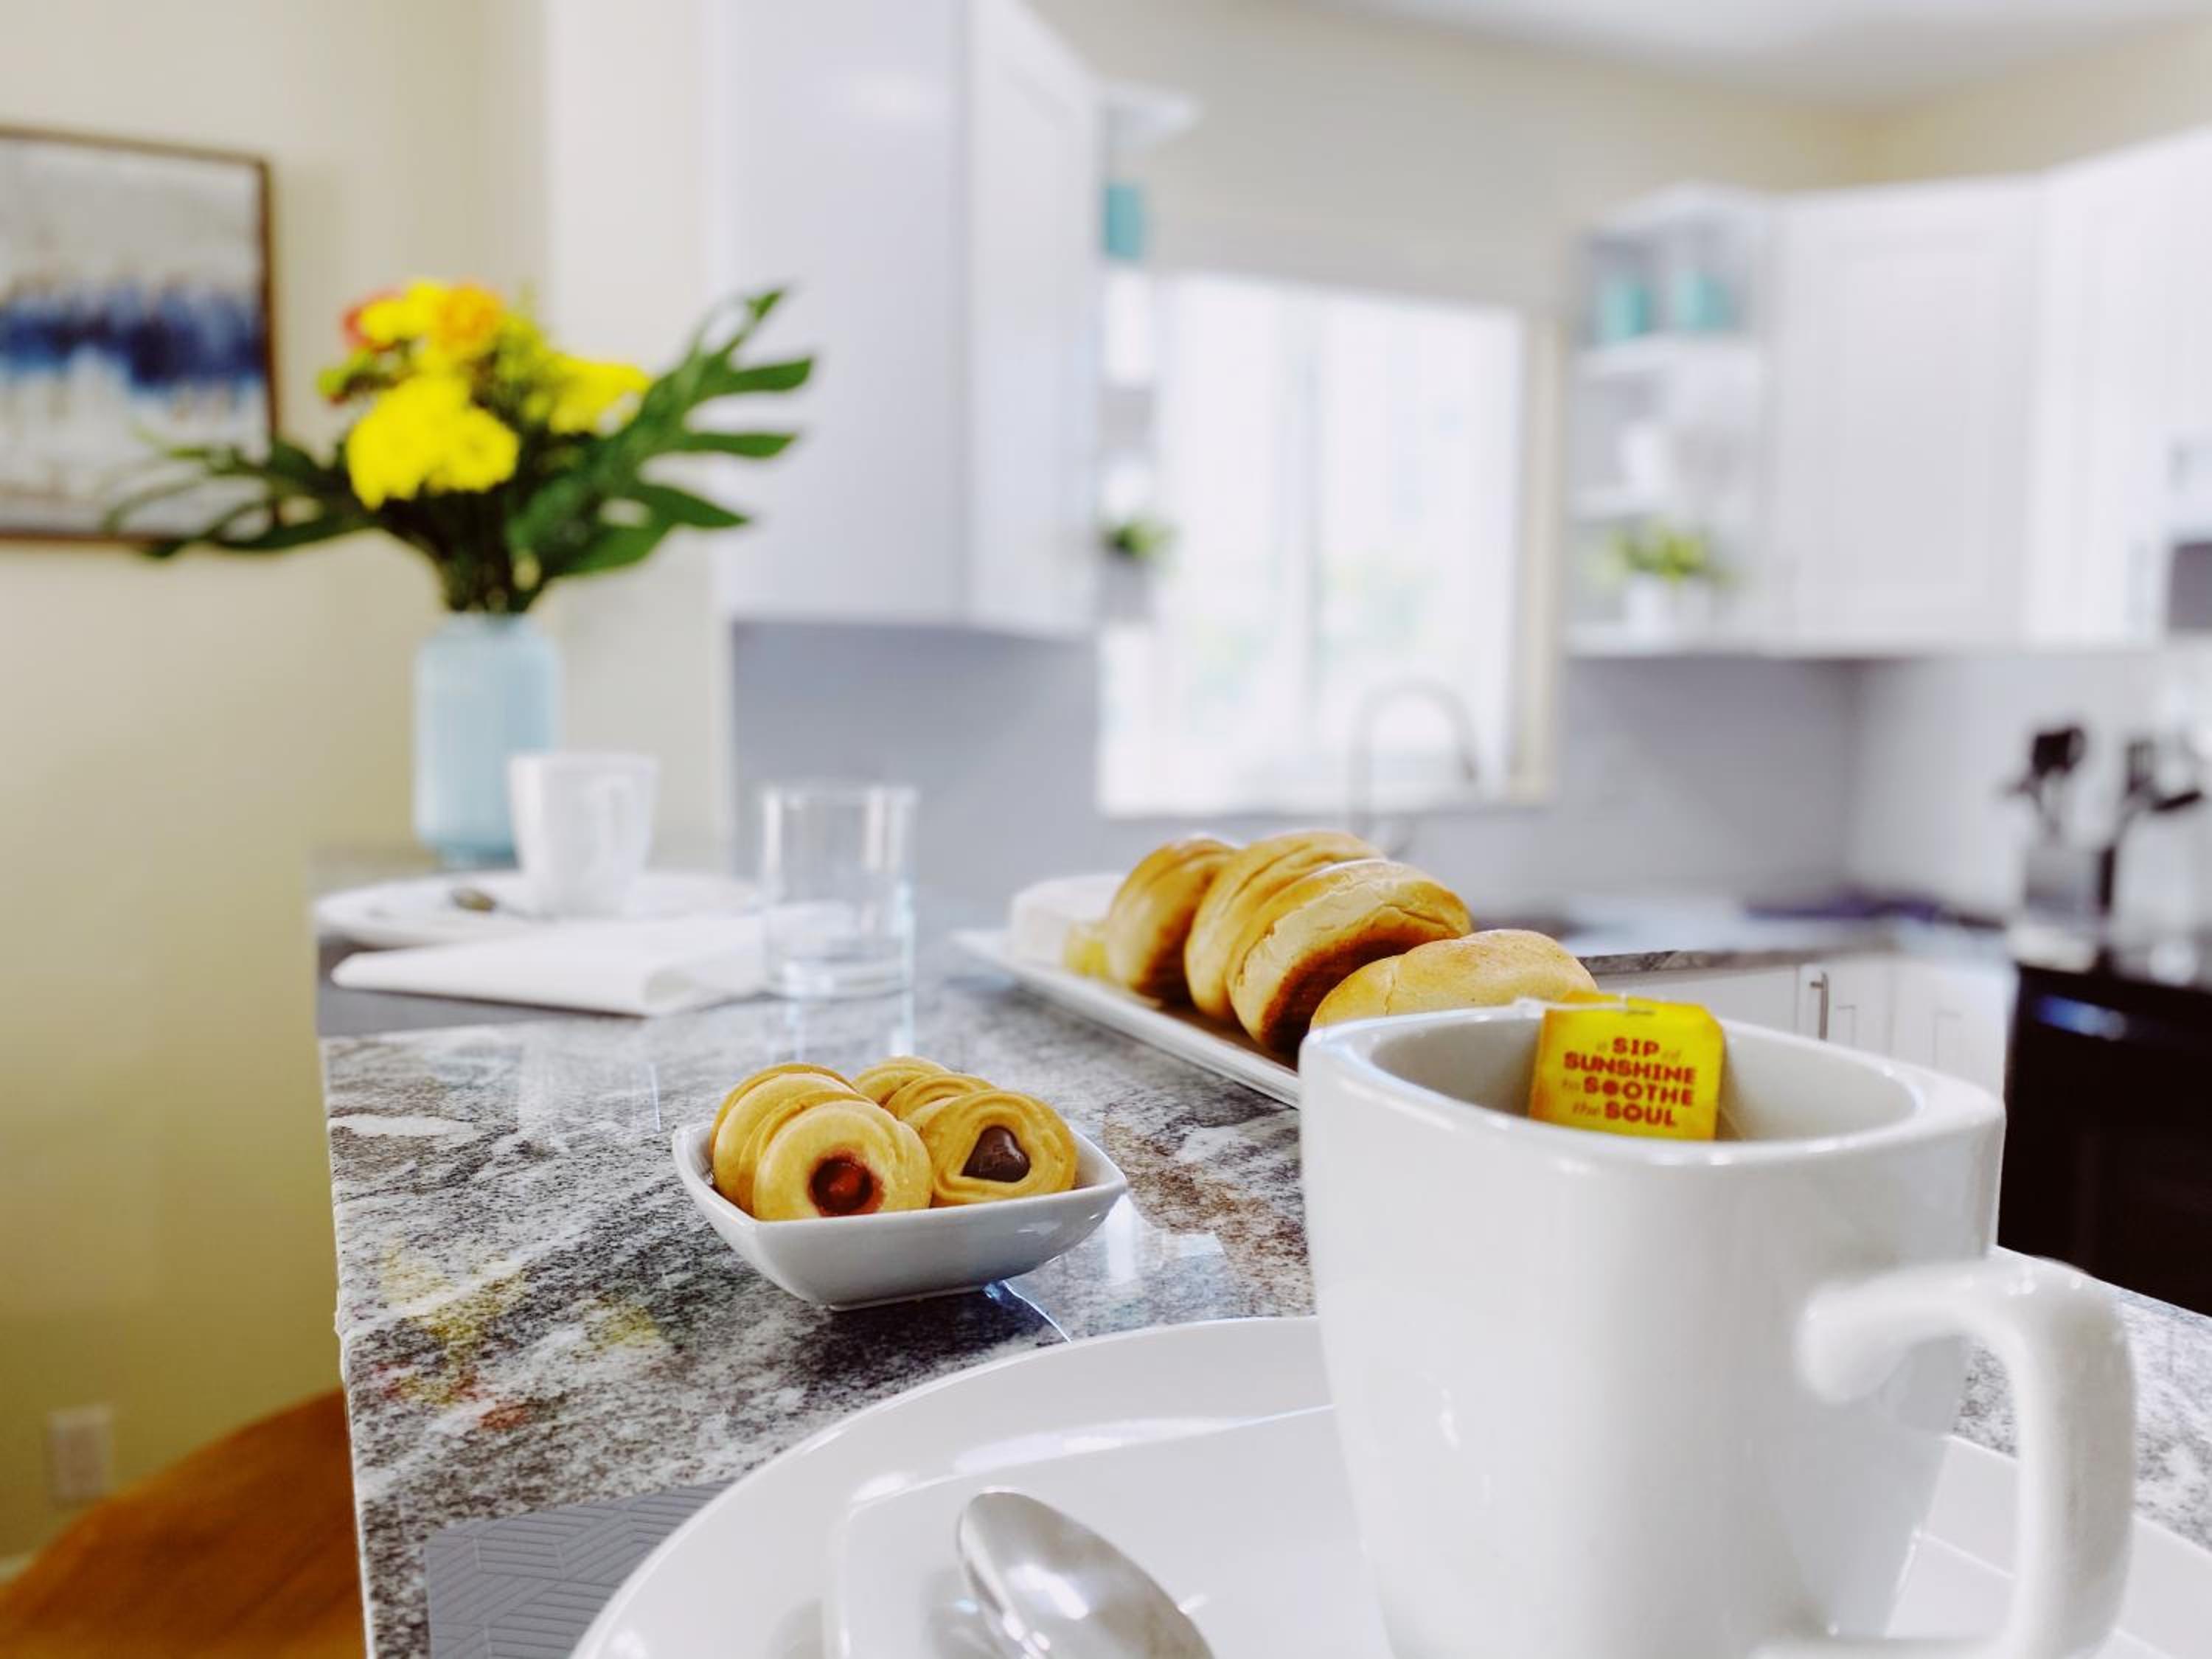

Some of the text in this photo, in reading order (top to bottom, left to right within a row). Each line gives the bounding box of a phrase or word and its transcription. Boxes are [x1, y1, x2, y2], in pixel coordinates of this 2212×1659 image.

[1612, 1037, 1660, 1057] SIP
[1564, 1051, 1696, 1085] SUNSHINE
[1584, 1076, 1694, 1107] SOOTHE
[1604, 1100, 1677, 1127] SOUL
